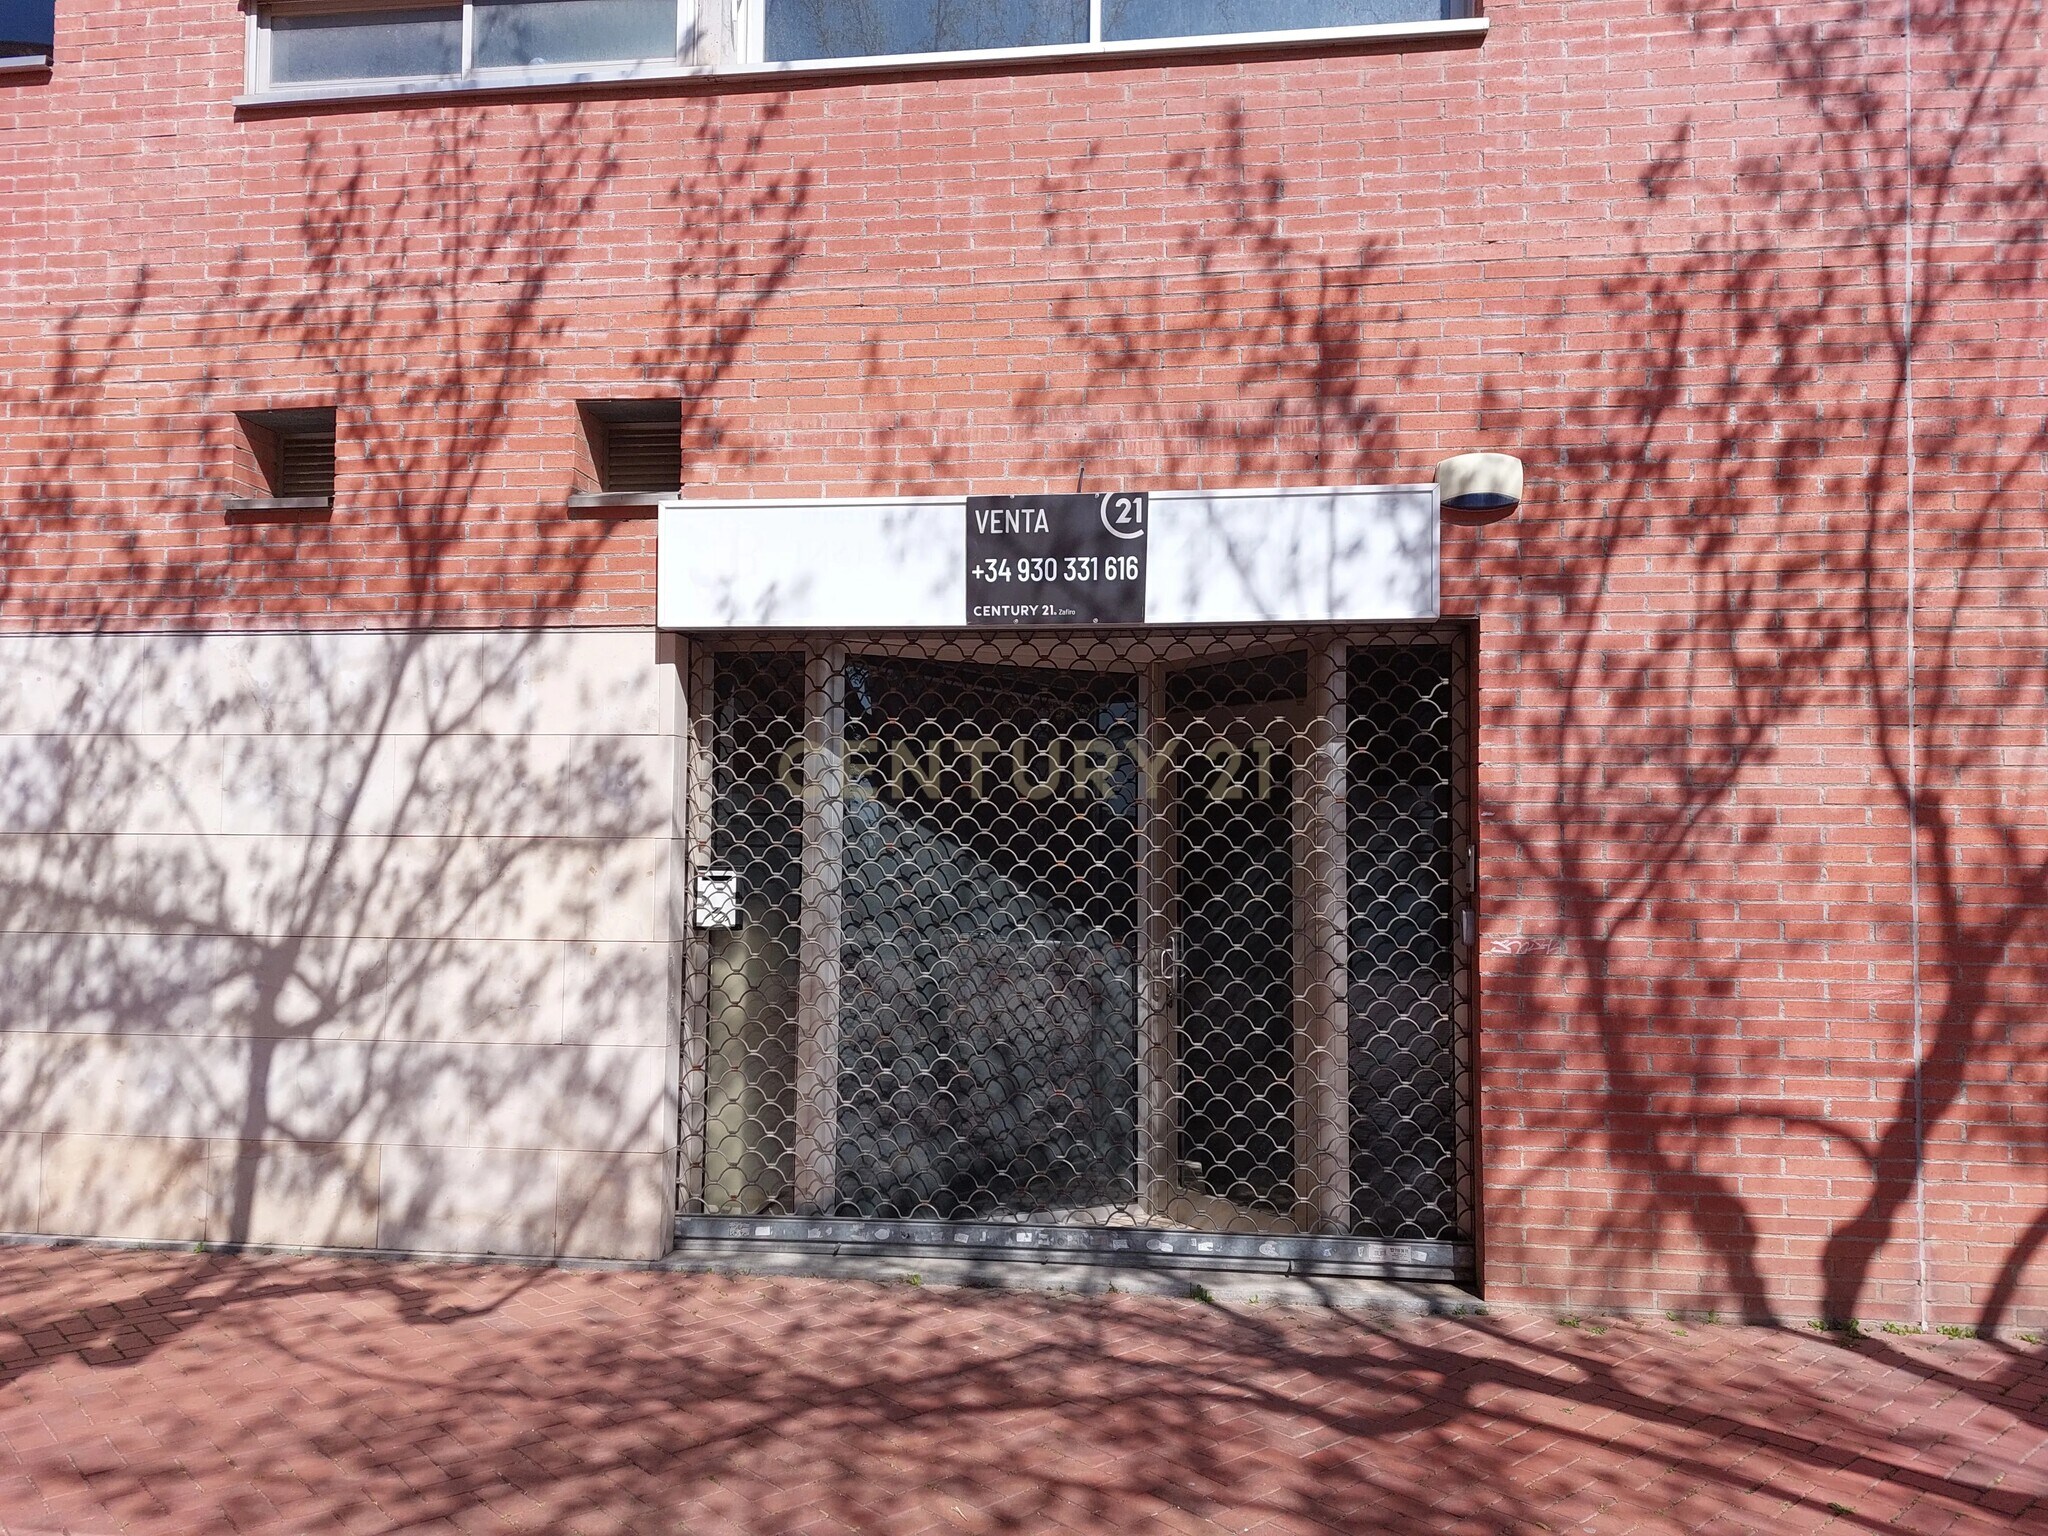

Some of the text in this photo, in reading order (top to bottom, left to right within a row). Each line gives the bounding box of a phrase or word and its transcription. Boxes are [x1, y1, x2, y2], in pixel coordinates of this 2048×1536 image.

[974, 508, 1050, 534] VENTA
[972, 555, 1139, 583] +34 930 331 616
[973, 604, 1039, 617] CENTURY
[1058, 608, 1076, 616] Zafiro
[778, 737, 1271, 800] CENTURY 21
